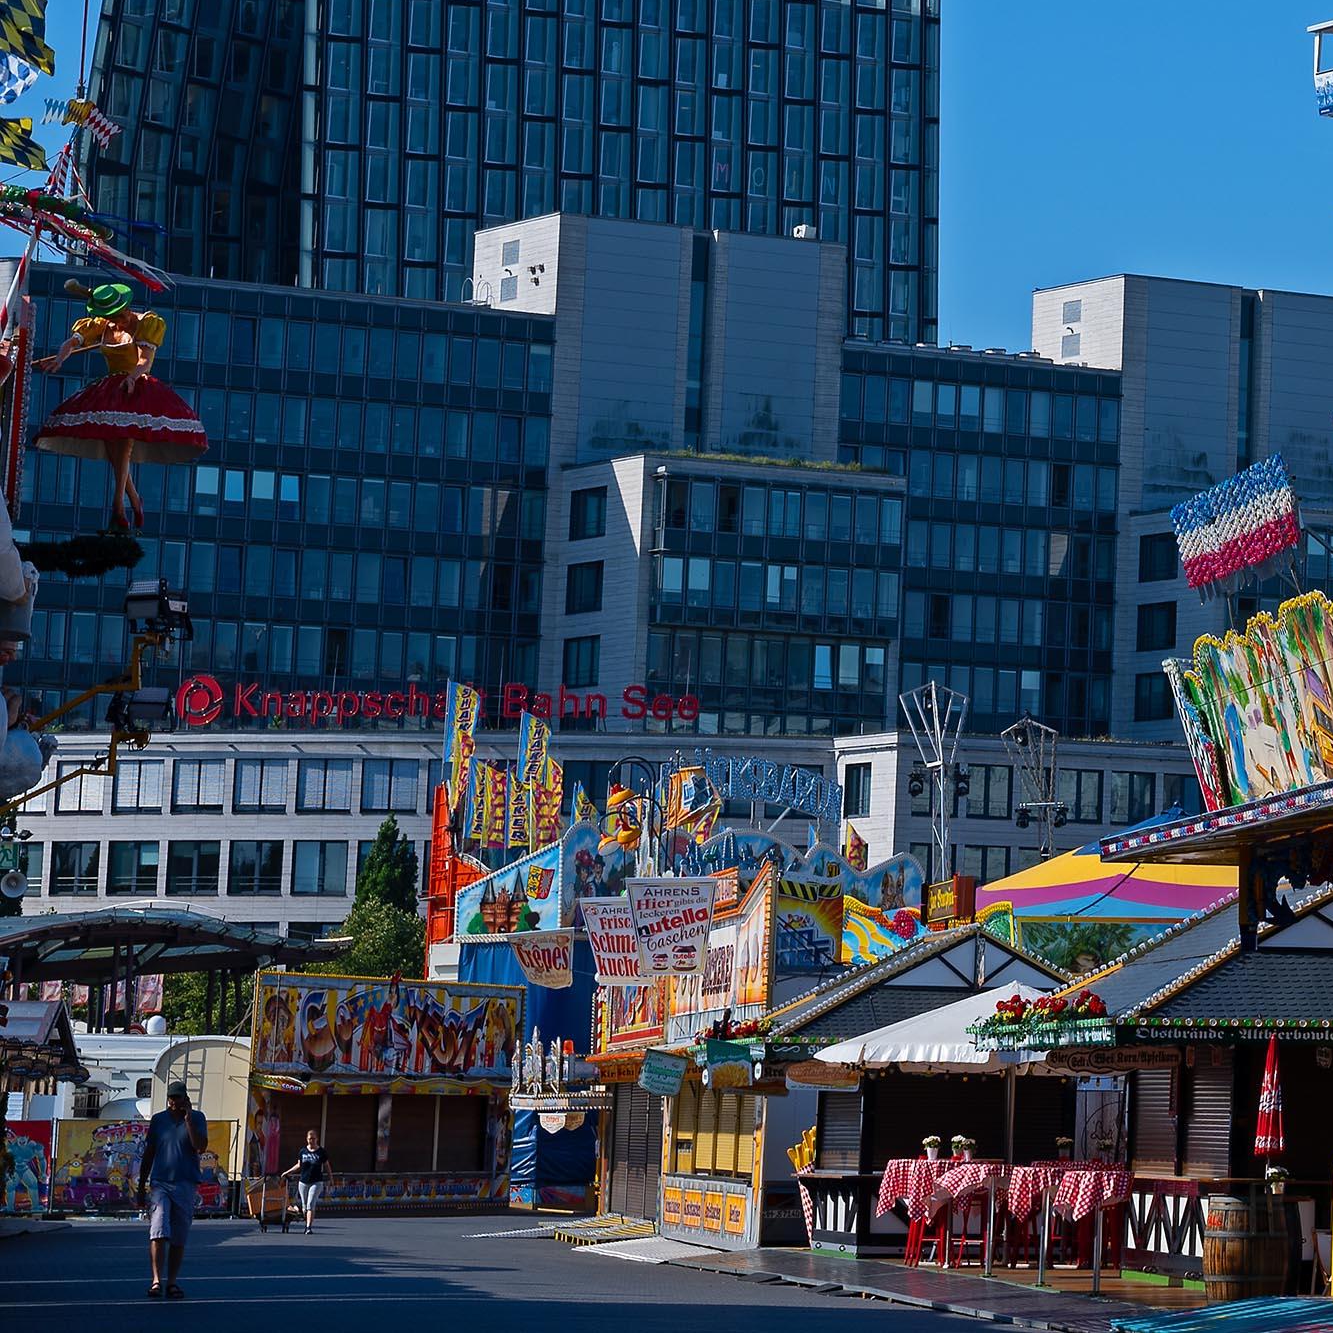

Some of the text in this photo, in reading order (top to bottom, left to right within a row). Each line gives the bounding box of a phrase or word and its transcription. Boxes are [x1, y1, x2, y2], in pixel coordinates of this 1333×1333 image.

[234, 682, 699, 726] Knappschat Bahn See
[643, 886, 700, 897] AHRENS
[600, 906, 630, 915] AHRE
[636, 896, 708, 911] Hier gibts die
[639, 908, 680, 920] leckeren
[599, 915, 633, 930] Frisc
[637, 907, 709, 938] nutella
[515, 944, 569, 973] Crêpes
[596, 954, 640, 978] kuche
[1136, 1026, 1225, 1040] Obstbrände
